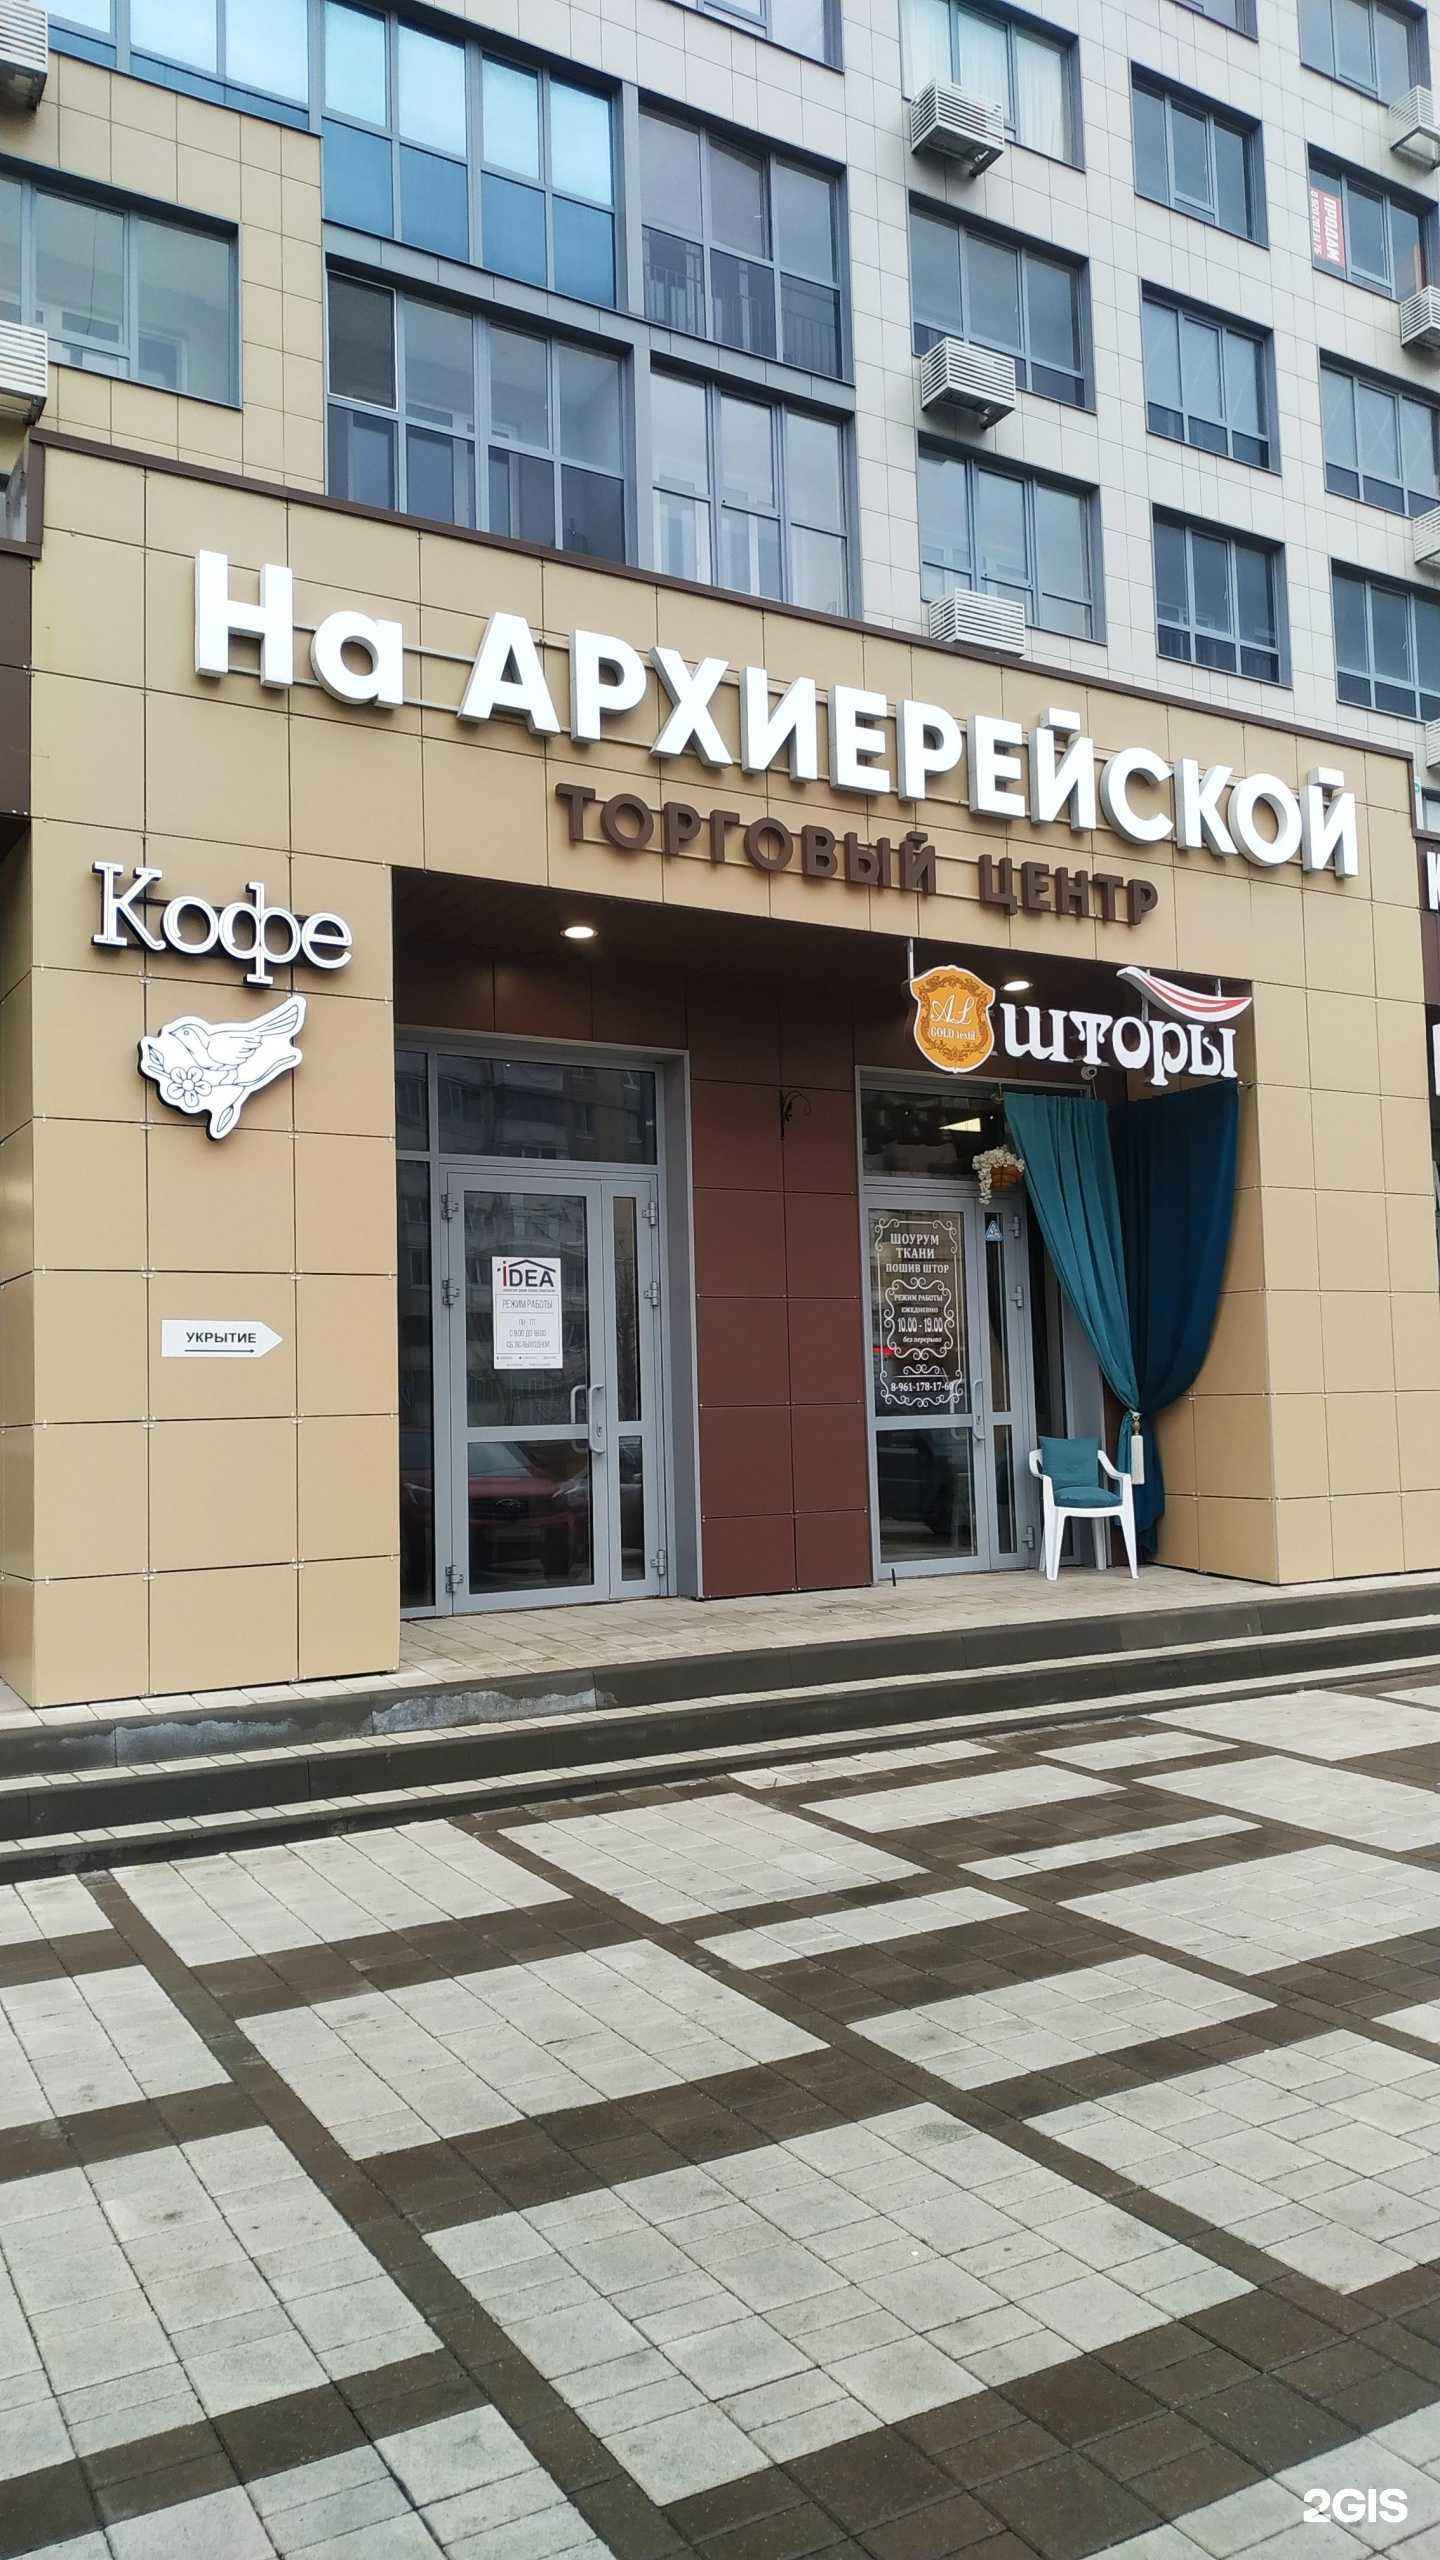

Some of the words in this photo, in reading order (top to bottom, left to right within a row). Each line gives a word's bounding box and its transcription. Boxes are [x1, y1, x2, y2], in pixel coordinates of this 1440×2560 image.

[1323, 196, 1340, 261] ПРОДАМ
[195, 549, 404, 712] На
[457, 611, 1359, 879] АРХИЕРЕЙСКОЙ
[555, 782, 937, 896] ТОРГОВЫЙ
[978, 853, 1159, 926] ЦЕНТР
[92, 861, 354, 986] Кофе
[931, 1026, 954, 1039] GOLD
[1000, 1002, 1238, 1087] шторы
[890, 1233, 939, 1246] ШОУРУМ
[896, 1247, 935, 1259] ТКАНИ
[885, 1263, 921, 1274] ПОШИВ
[923, 1263, 950, 1275] ШТОР
[502, 1299, 526, 1309] РЕЖИМ
[527, 1299, 552, 1309] РАБОТЫ
[894, 1294, 917, 1302] РЕЖИМ
[918, 1294, 943, 1302] РАБОТЫ
[898, 1317, 918, 1333] 10.00
[924, 1317, 943, 1333] 19.00
[185, 1332, 257, 1344] УКРЫТИЕ
